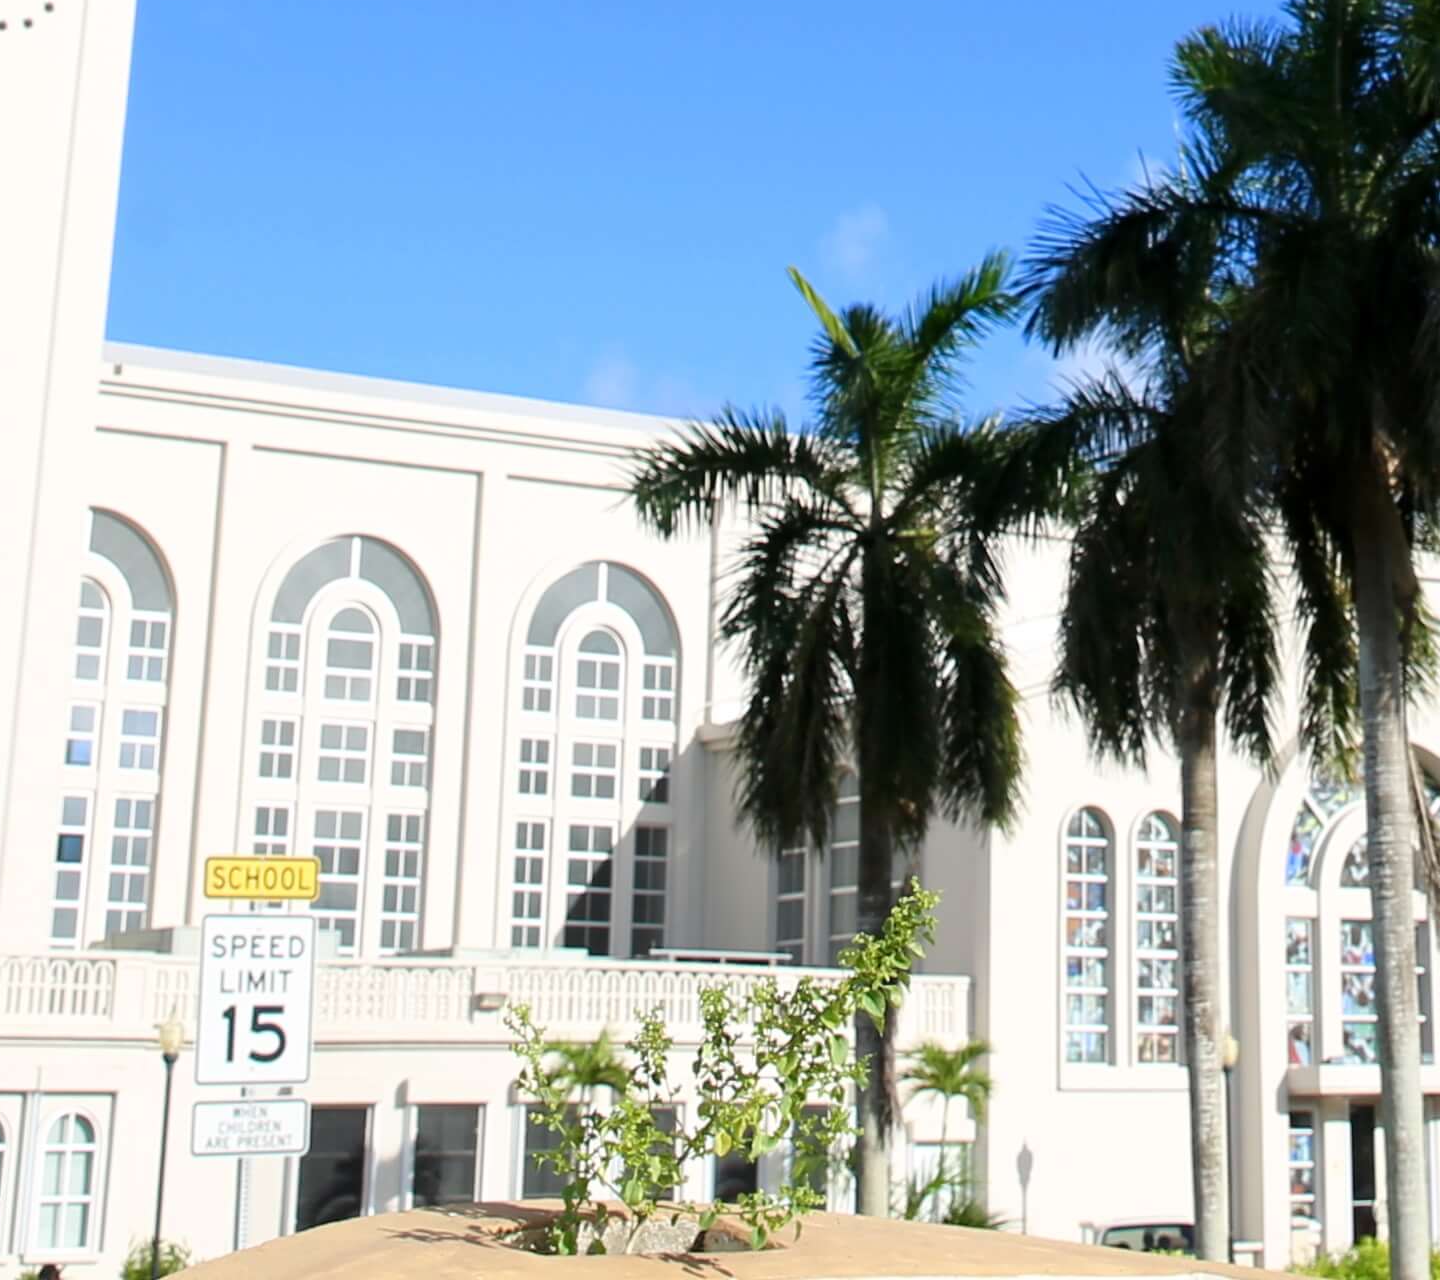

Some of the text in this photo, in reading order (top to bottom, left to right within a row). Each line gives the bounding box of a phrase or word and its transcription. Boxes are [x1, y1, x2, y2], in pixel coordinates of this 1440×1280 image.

[212, 866, 311, 890] SCHOOL
[212, 935, 305, 958] SPEED
[220, 970, 293, 993] LIMIT
[221, 1005, 287, 1063] 15
[233, 1107, 267, 1118] WHEN
[218, 1120, 281, 1134] CHILDREN
[206, 1134, 293, 1149] ARE PRESENT
